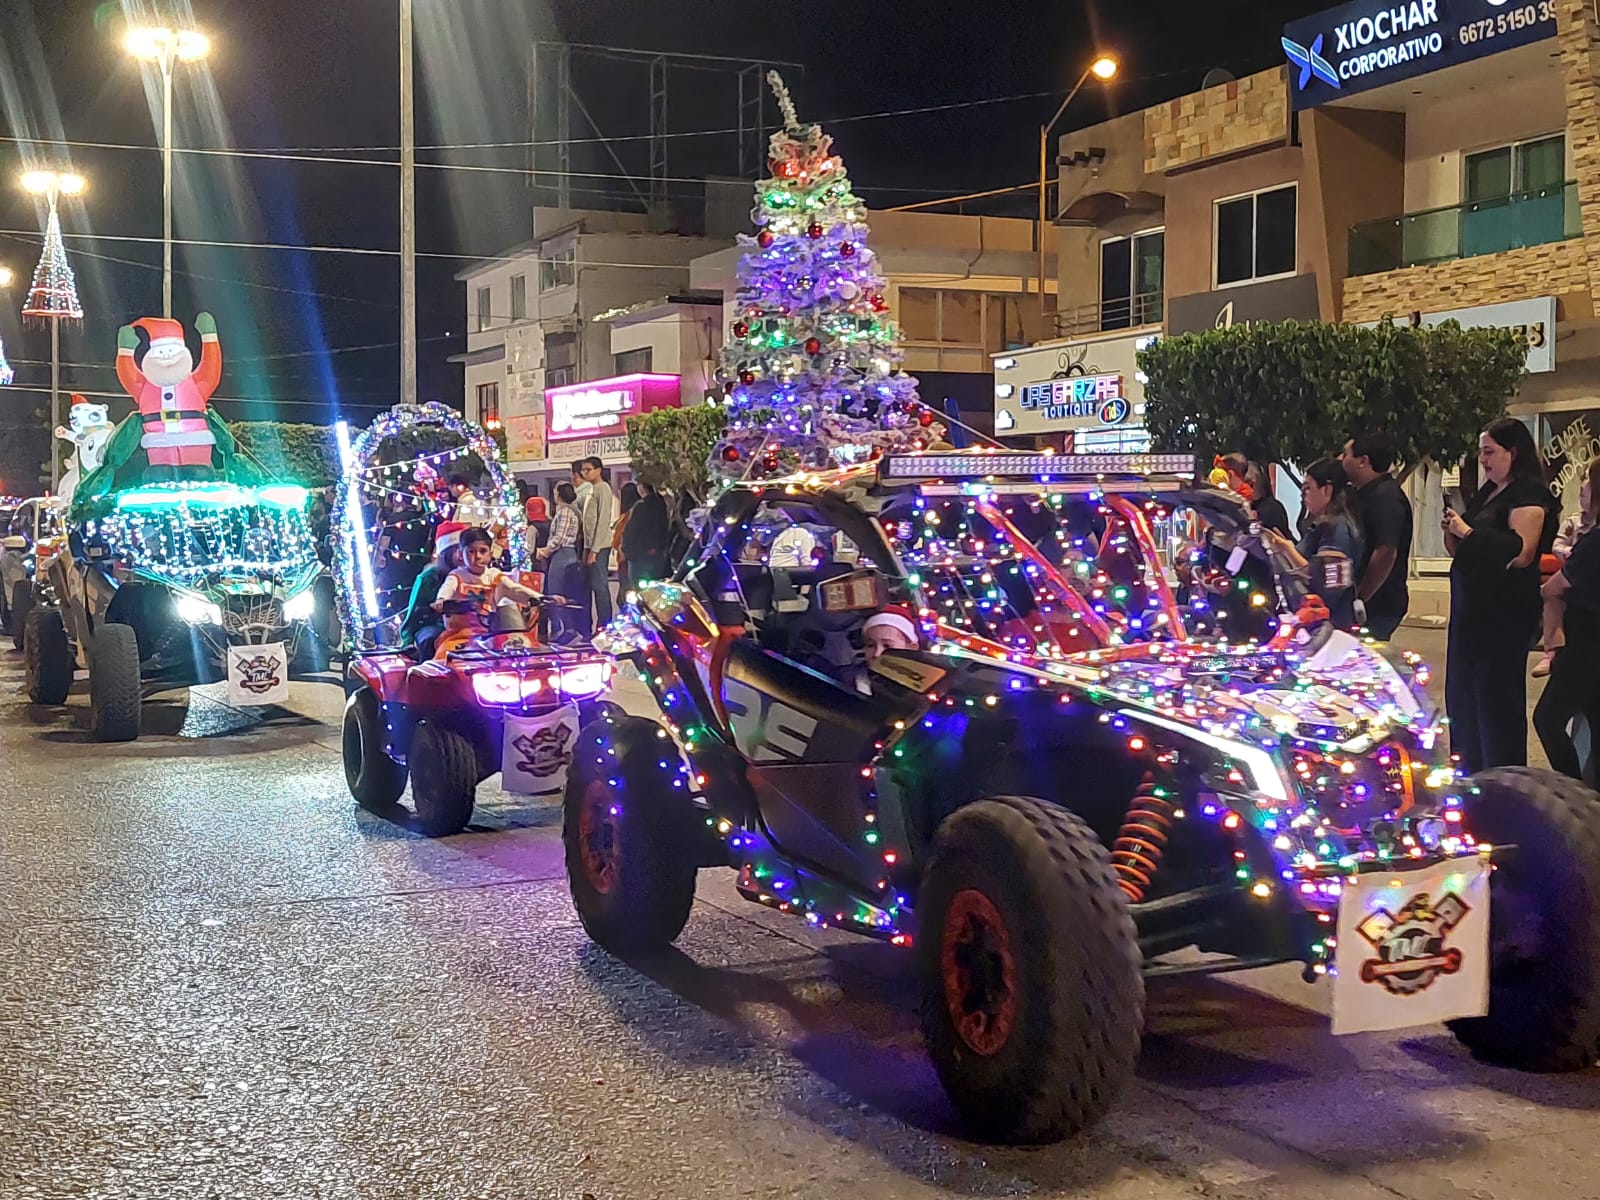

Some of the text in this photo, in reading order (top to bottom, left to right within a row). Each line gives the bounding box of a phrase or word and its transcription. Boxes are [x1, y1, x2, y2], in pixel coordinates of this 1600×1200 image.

[1334, 0, 1440, 53] XIOCHAR
[1459, 18, 1495, 45] 6672
[1497, 5, 1536, 34] 5150
[1339, 32, 1442, 80] CORPORATIVO
[1020, 374, 1120, 409] LAS GARZAS
[1043, 402, 1095, 419] BOUTIQUE
[584, 437, 629, 456] (667)758.29
[1542, 413, 1591, 466] REMATE
[1549, 437, 1600, 498] QUIDACIO
